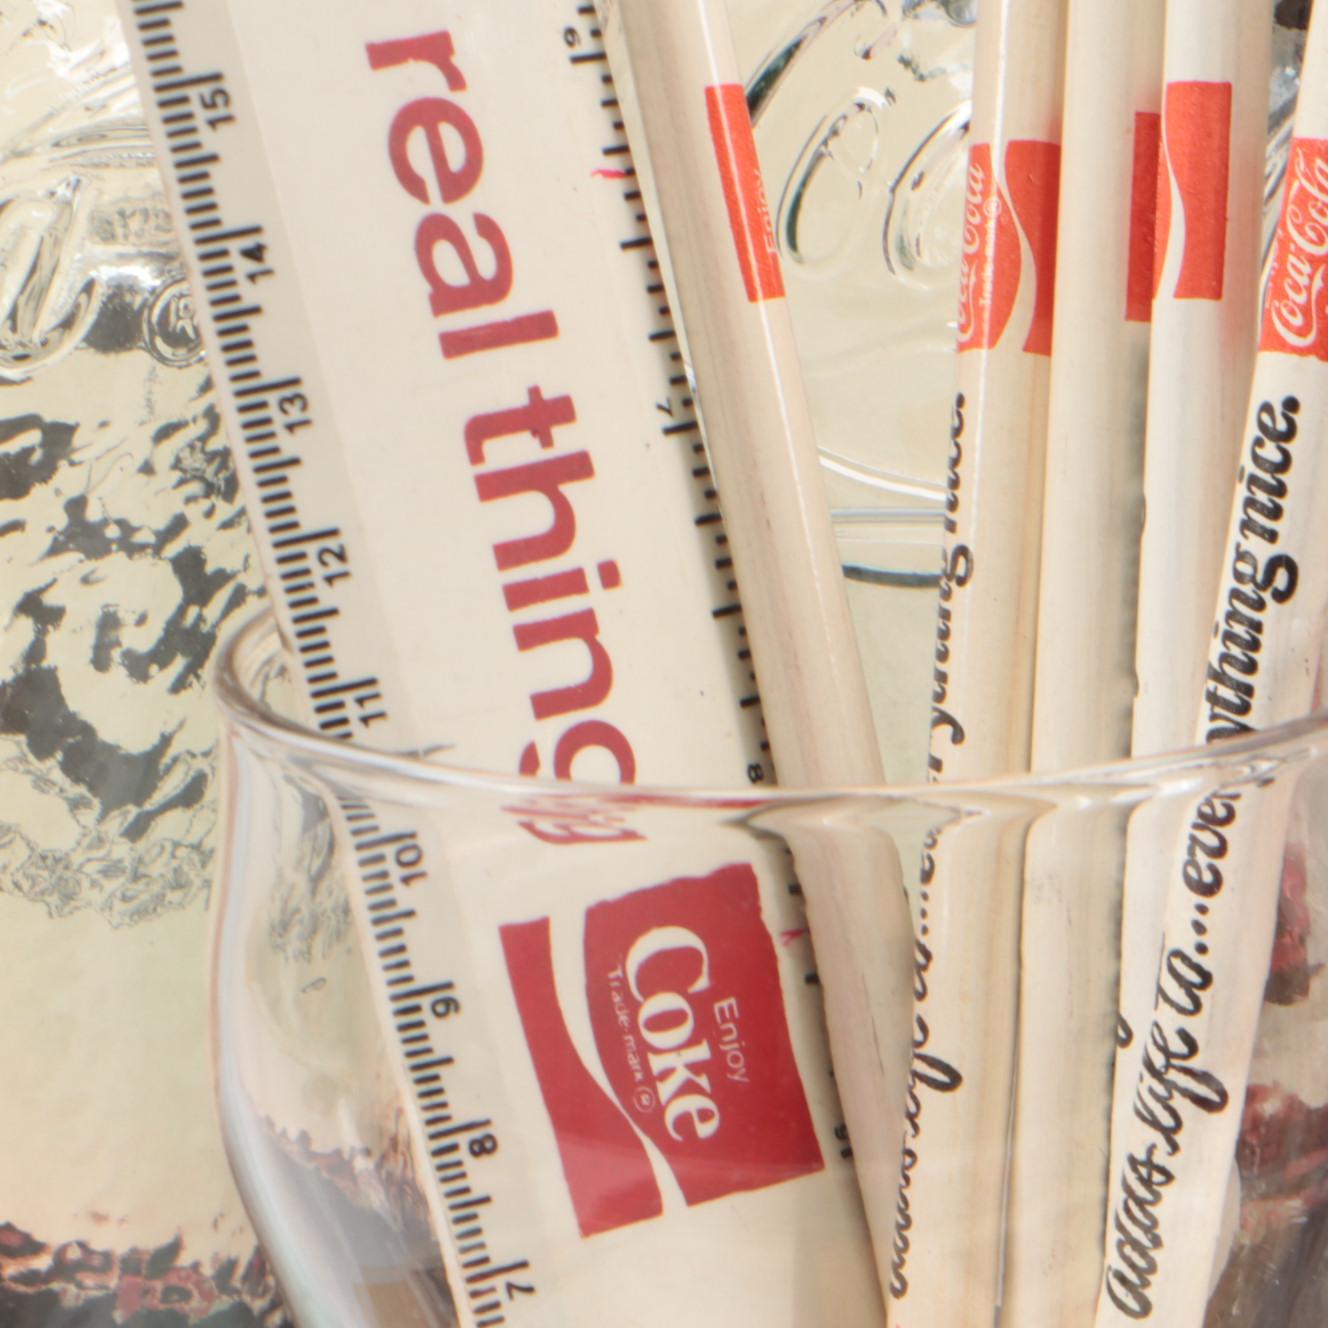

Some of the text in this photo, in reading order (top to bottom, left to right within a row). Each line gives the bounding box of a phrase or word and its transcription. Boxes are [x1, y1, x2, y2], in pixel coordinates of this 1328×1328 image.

[199, 88, 235, 131] 15
[365, 29, 559, 360] real
[237, 242, 274, 285] 14
[279, 392, 312, 434] 13
[1240, 394, 1301, 546] nice.
[317, 546, 351, 588] 12
[356, 694, 389, 729] 11
[747, 763, 764, 783] 8
[393, 843, 428, 889] 10
[429, 994, 461, 1020] 9
[624, 924, 721, 1143] Coke
[713, 996, 750, 1086] Enjoy
[1134, 1018, 1229, 1157] life
[467, 1132, 499, 1159] 8
[1106, 1142, 1177, 1321] adds
[504, 1279, 537, 1302] 7
